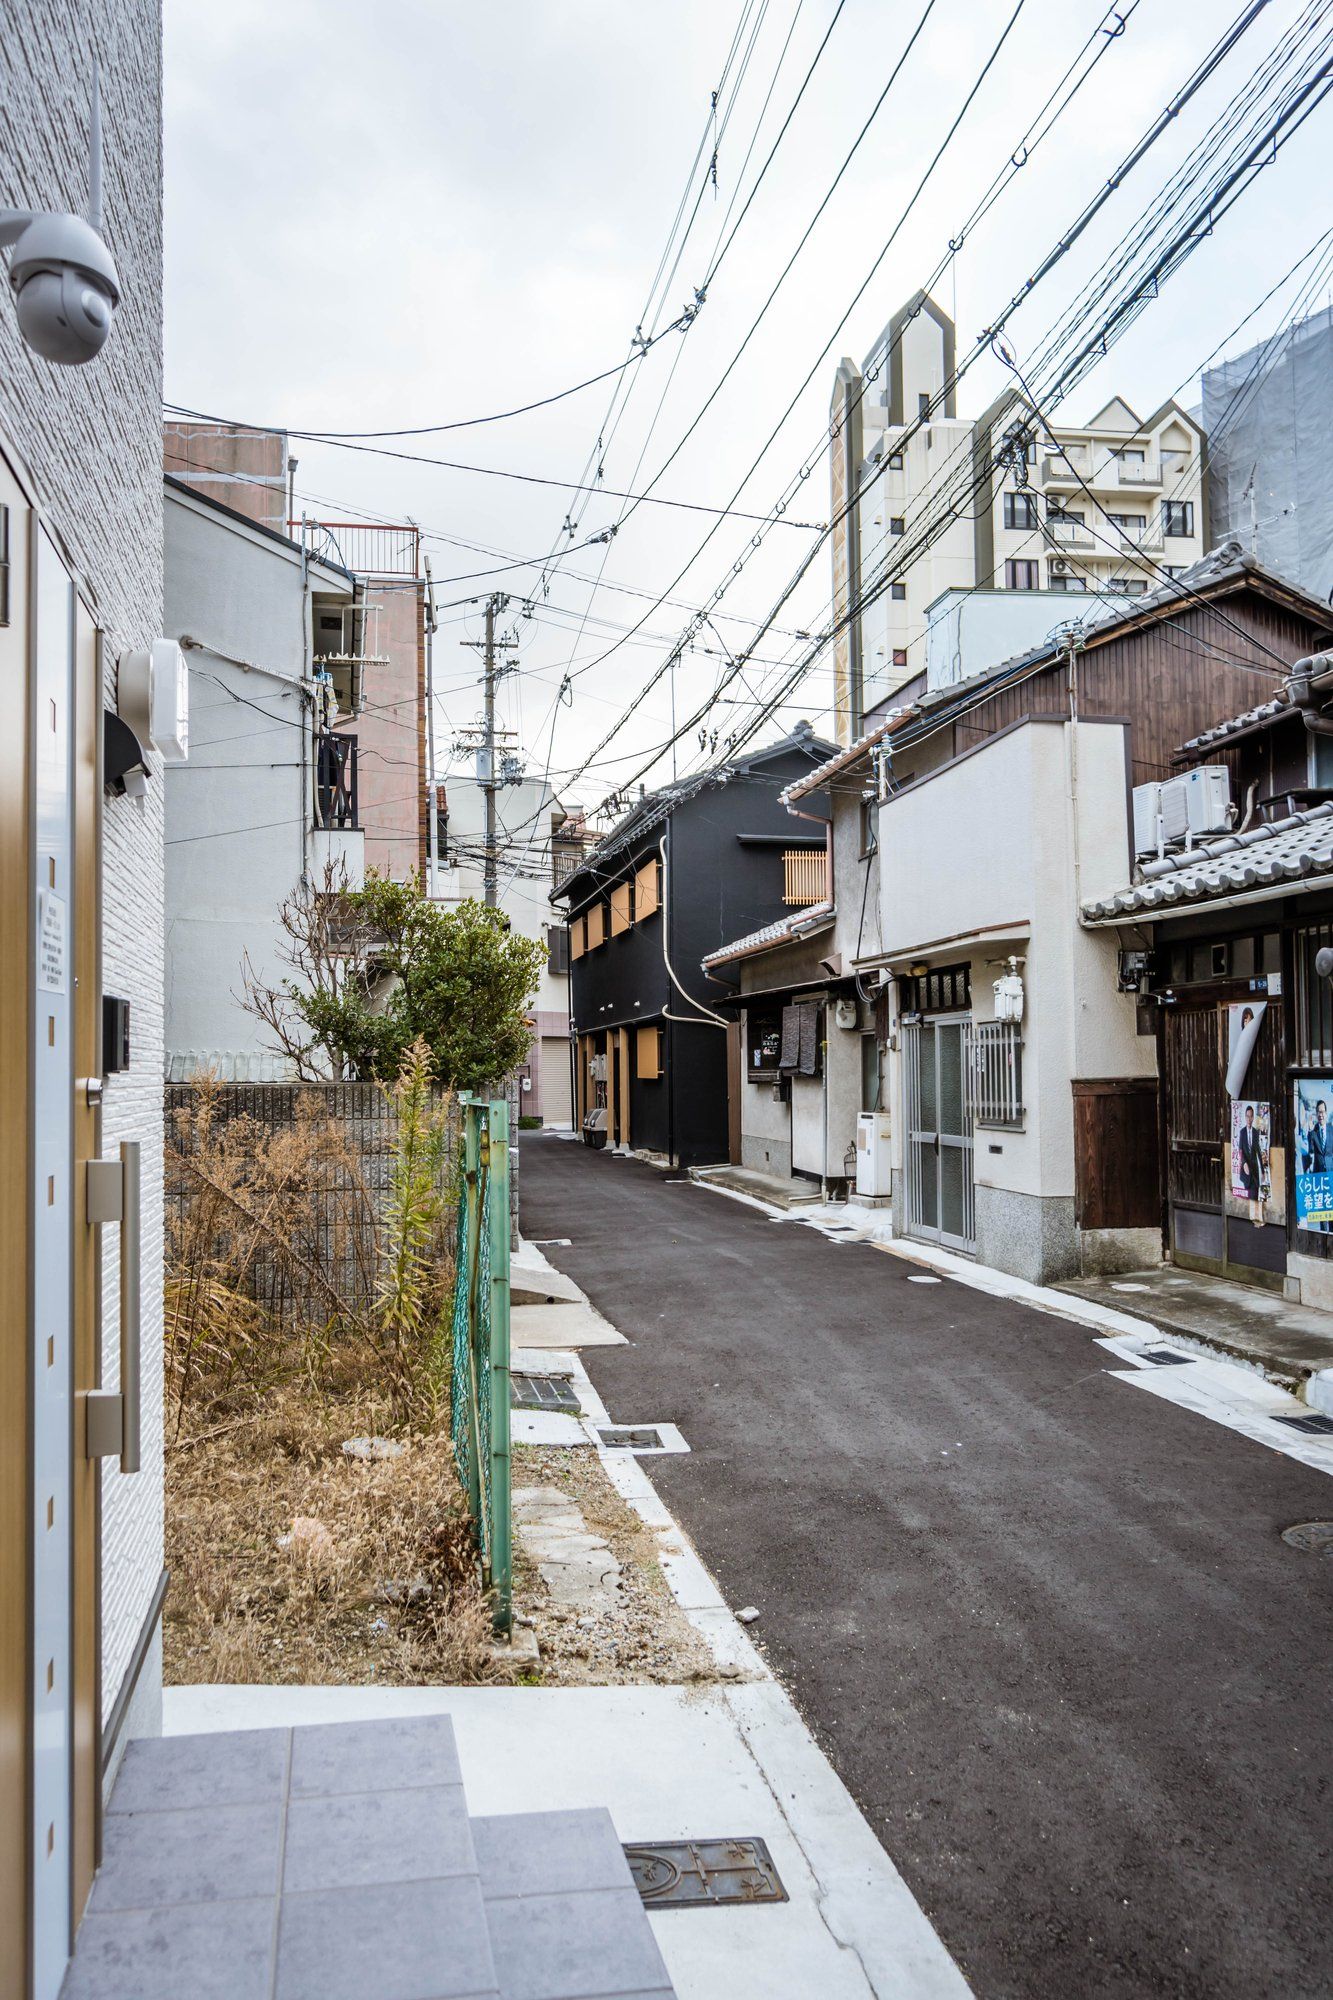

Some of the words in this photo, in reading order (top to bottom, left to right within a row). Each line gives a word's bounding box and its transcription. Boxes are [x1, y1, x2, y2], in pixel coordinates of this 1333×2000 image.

[1299, 1177, 1330, 1193] くらしに
[1304, 1192, 1333, 1208] 希望を
